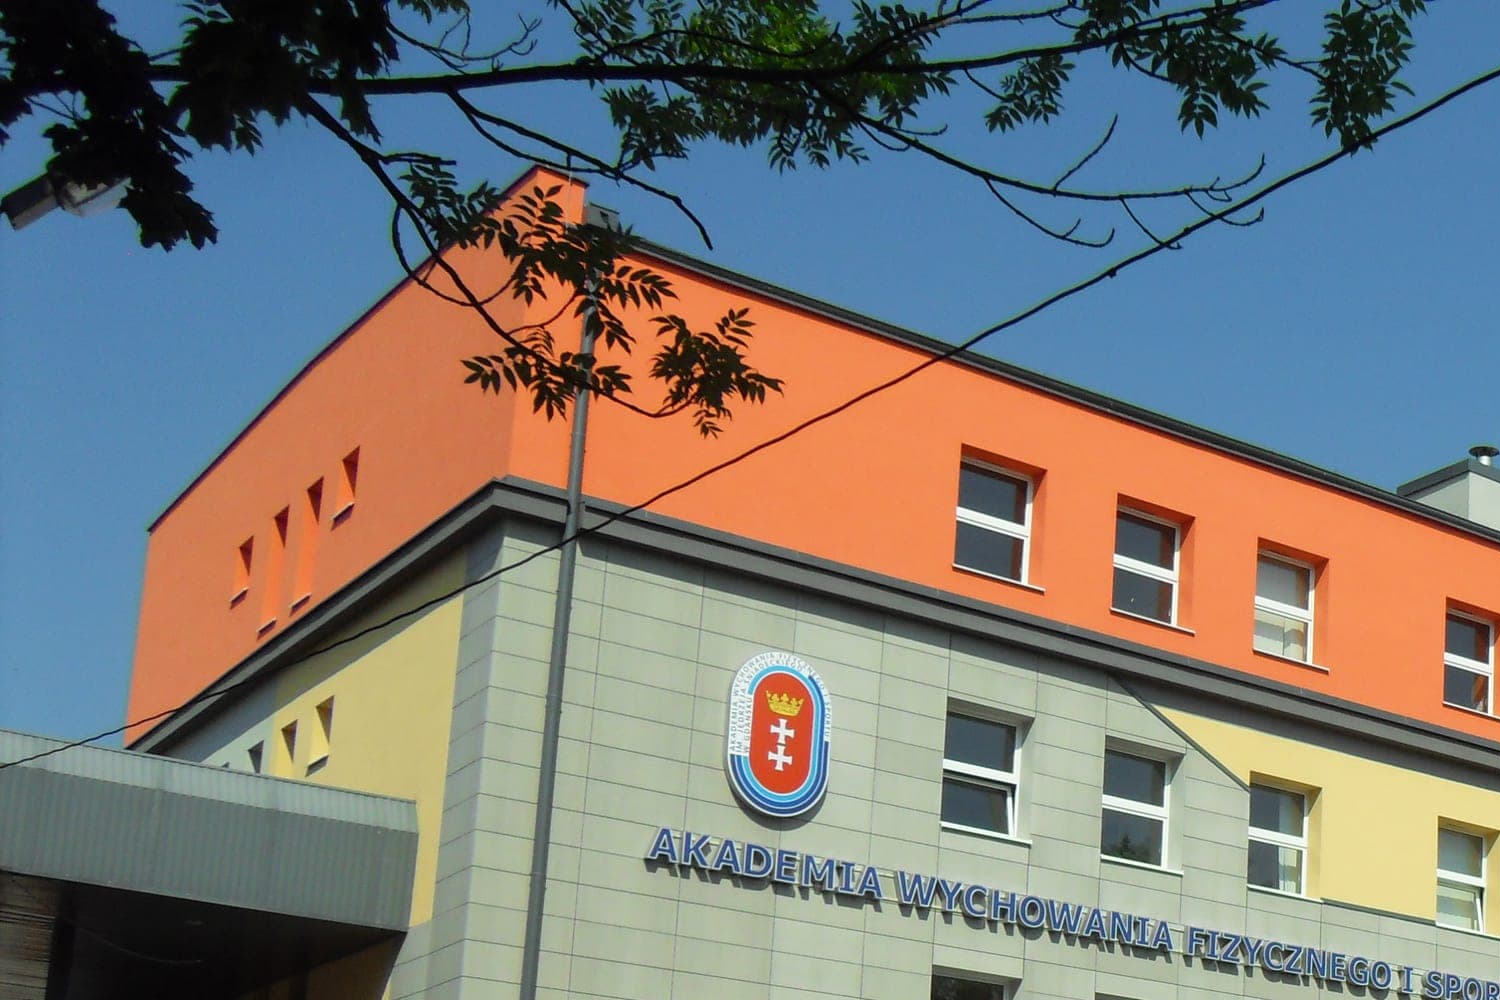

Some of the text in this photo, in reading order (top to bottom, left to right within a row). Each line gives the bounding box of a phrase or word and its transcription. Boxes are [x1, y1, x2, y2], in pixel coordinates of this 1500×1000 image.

[729, 700, 739, 751] AKADEMIA
[648, 827, 883, 898] AKADEMIA
[898, 870, 1174, 950] WYCHOWANIA
[1187, 926, 1392, 989] FIZYCZNEGO
[1402, 966, 1414, 993] I
